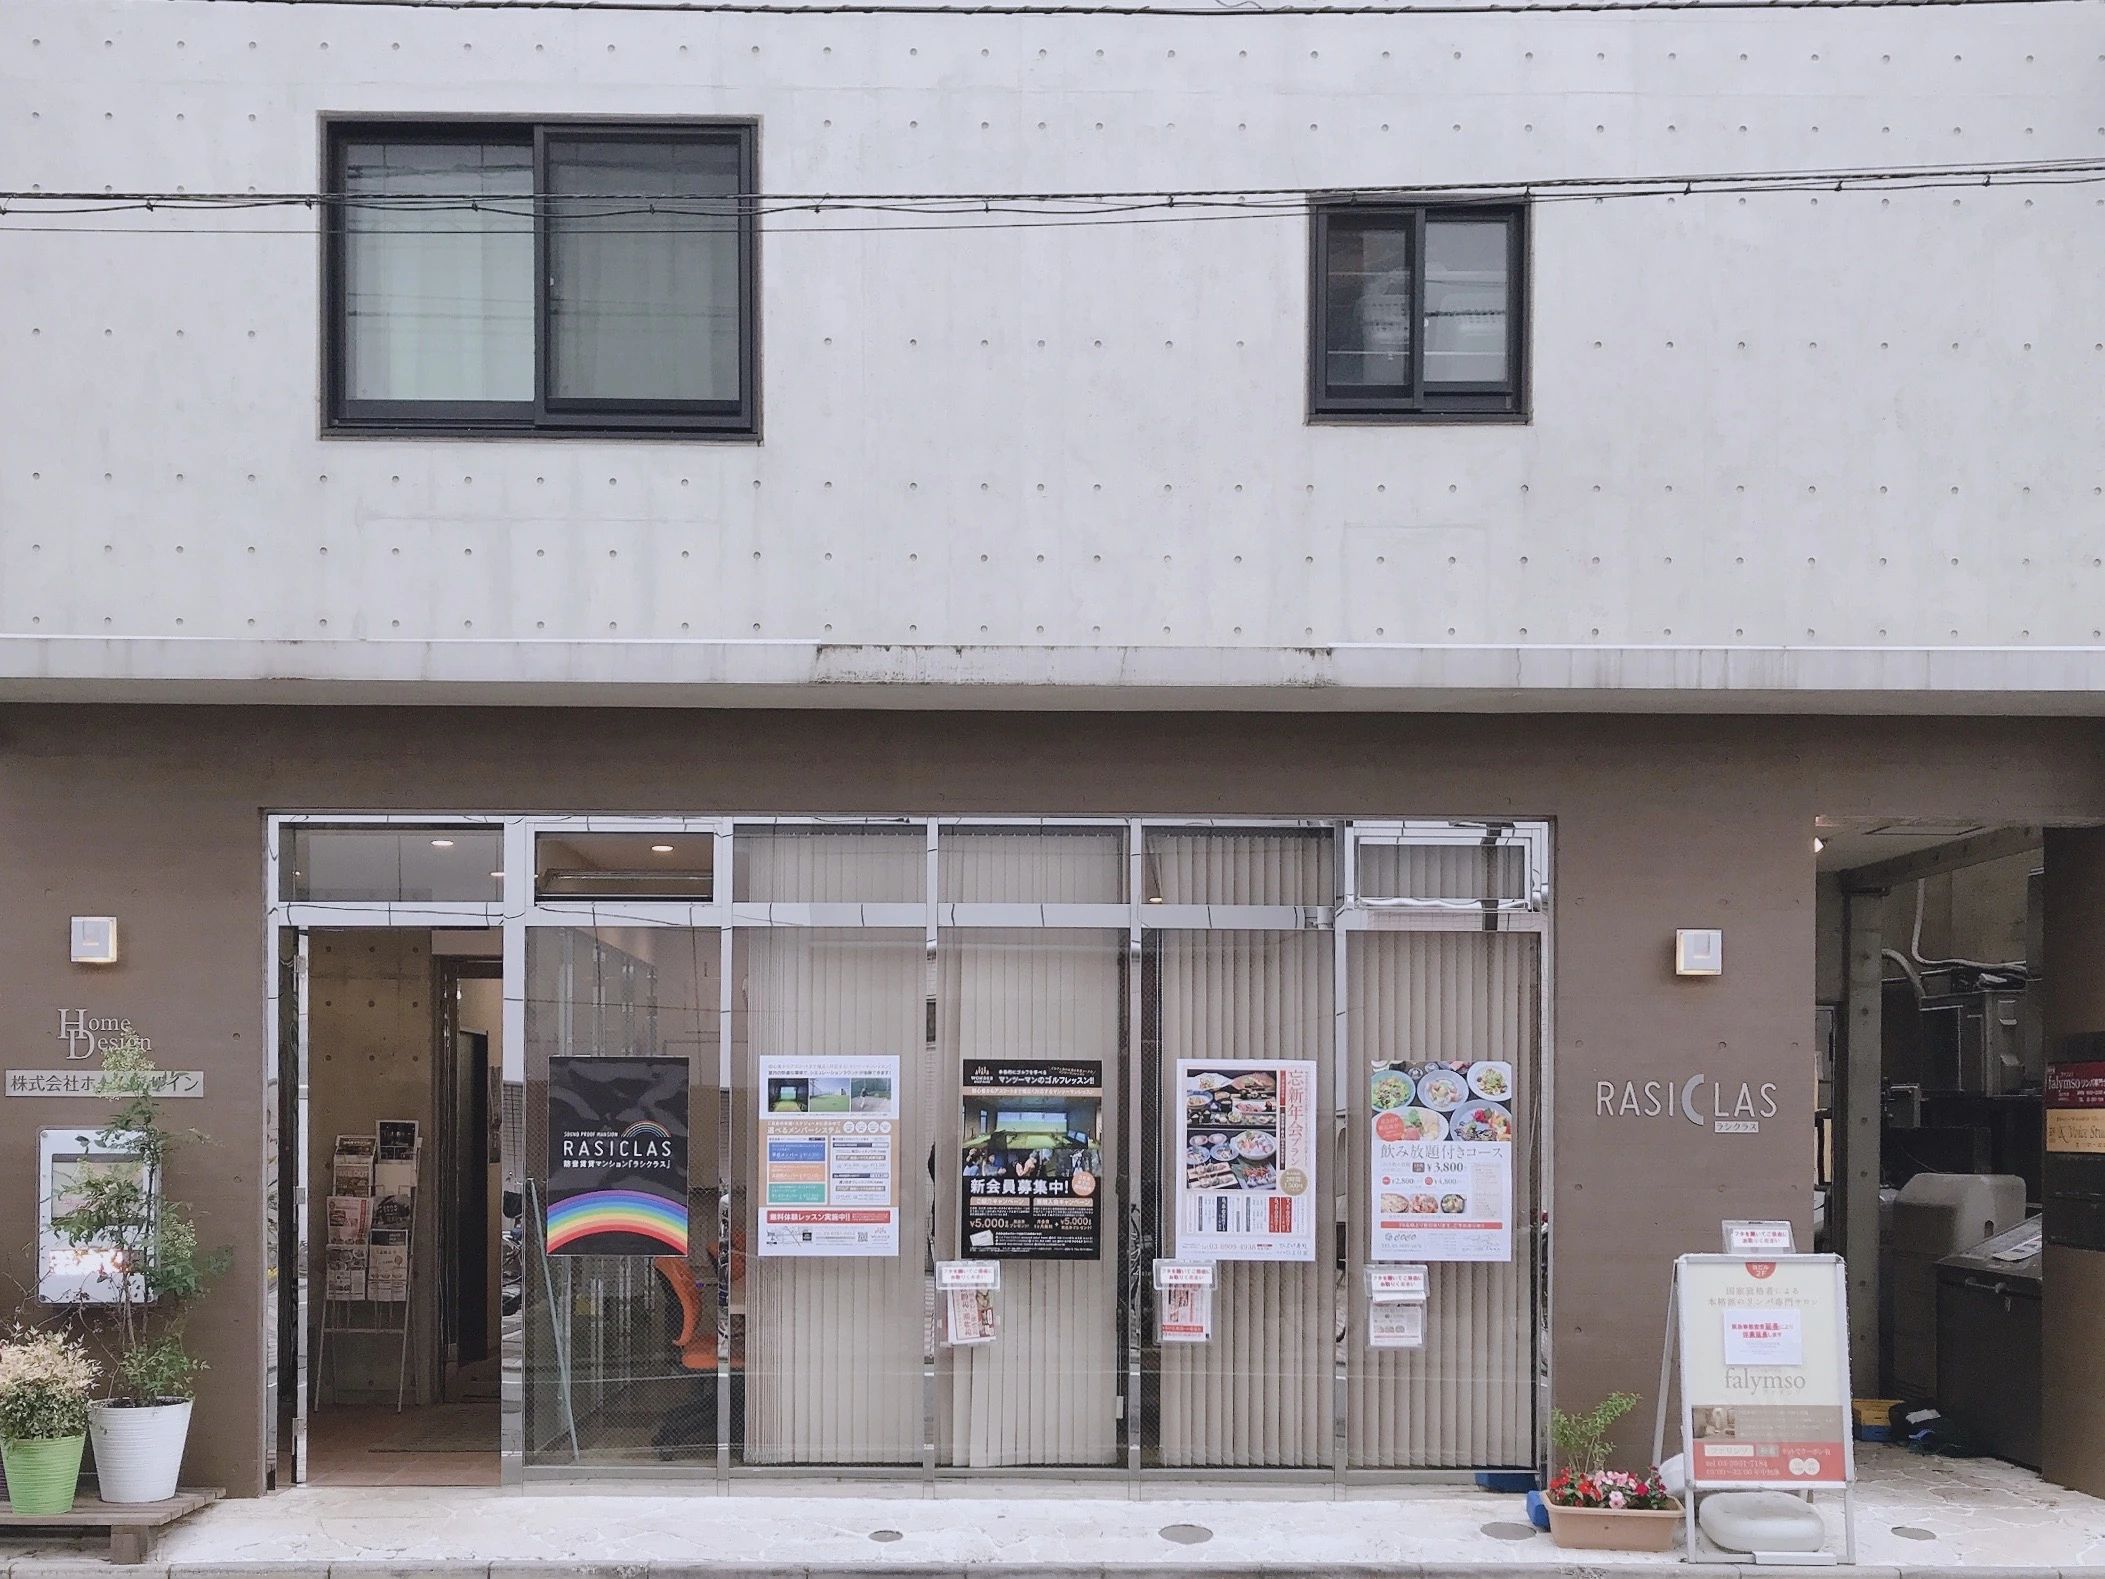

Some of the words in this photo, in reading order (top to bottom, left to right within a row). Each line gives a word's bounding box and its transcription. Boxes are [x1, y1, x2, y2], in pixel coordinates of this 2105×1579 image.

[57, 1008, 131, 1039] Home
[2048, 1075, 2080, 1091] falymso
[1596, 1074, 1777, 1125] RASICLAS
[1287, 1069, 1304, 1166] 忘新年会プラン
[767, 1126, 840, 1135] 選べるメンバーシステム
[1716, 1122, 1758, 1131] ラシクラス
[563, 1140, 672, 1157] RASICLAS
[1380, 1144, 1503, 1159] 飲み放題付きコース
[1427, 1162, 1464, 1173] ¥3,800
[970, 1179, 1069, 1195] 新会員募集中!
[1725, 1367, 1806, 1395] falymso
